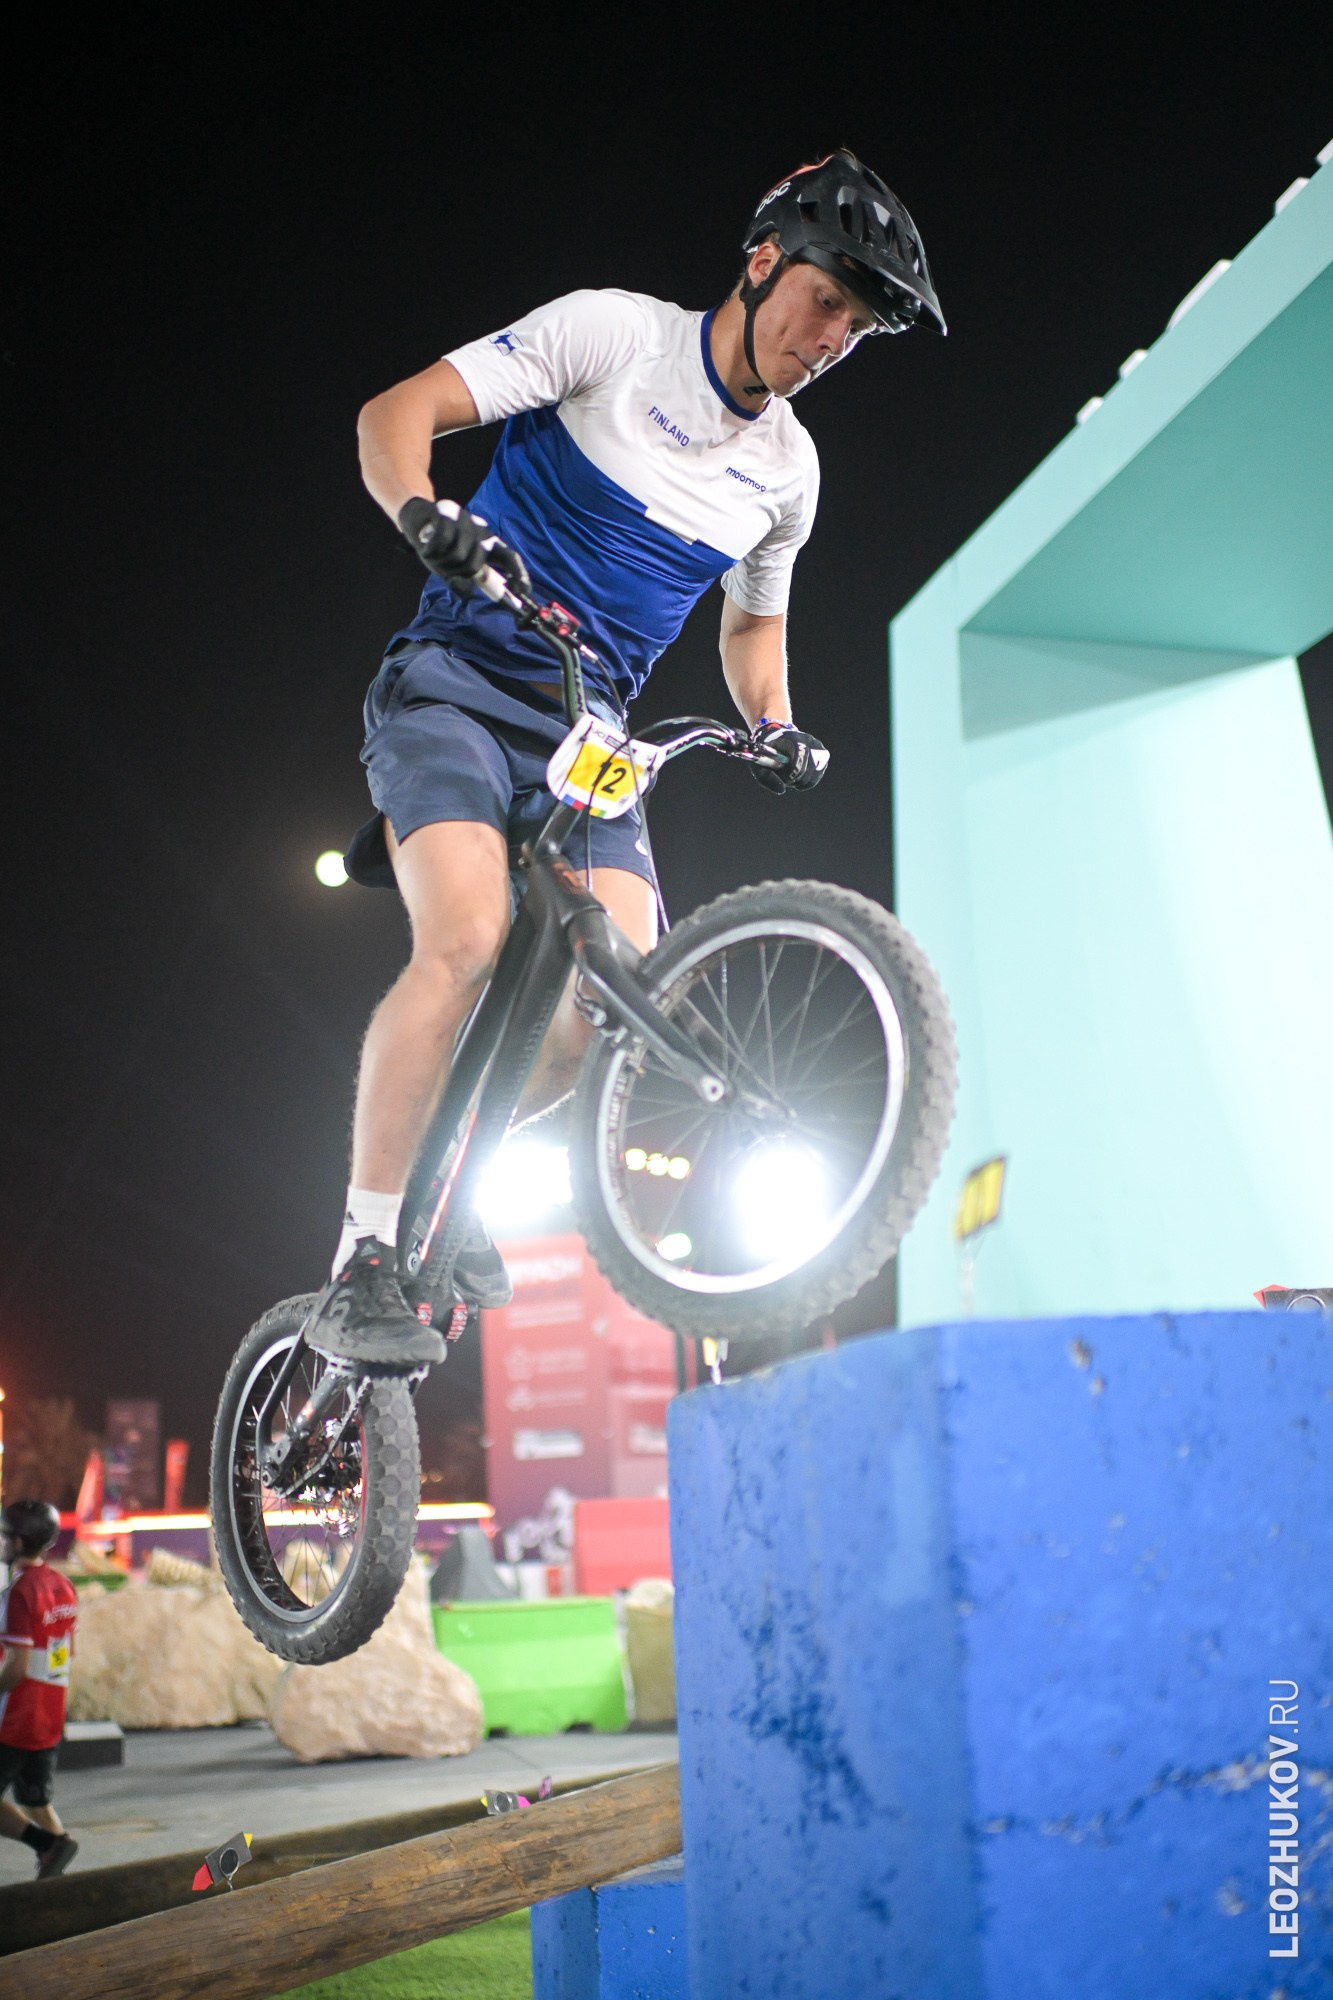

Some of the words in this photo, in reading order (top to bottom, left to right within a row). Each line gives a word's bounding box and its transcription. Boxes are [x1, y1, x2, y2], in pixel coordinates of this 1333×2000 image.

[648, 406, 690, 447] FINLAND
[725, 466, 767, 493] moomoo
[592, 761, 627, 794] 12
